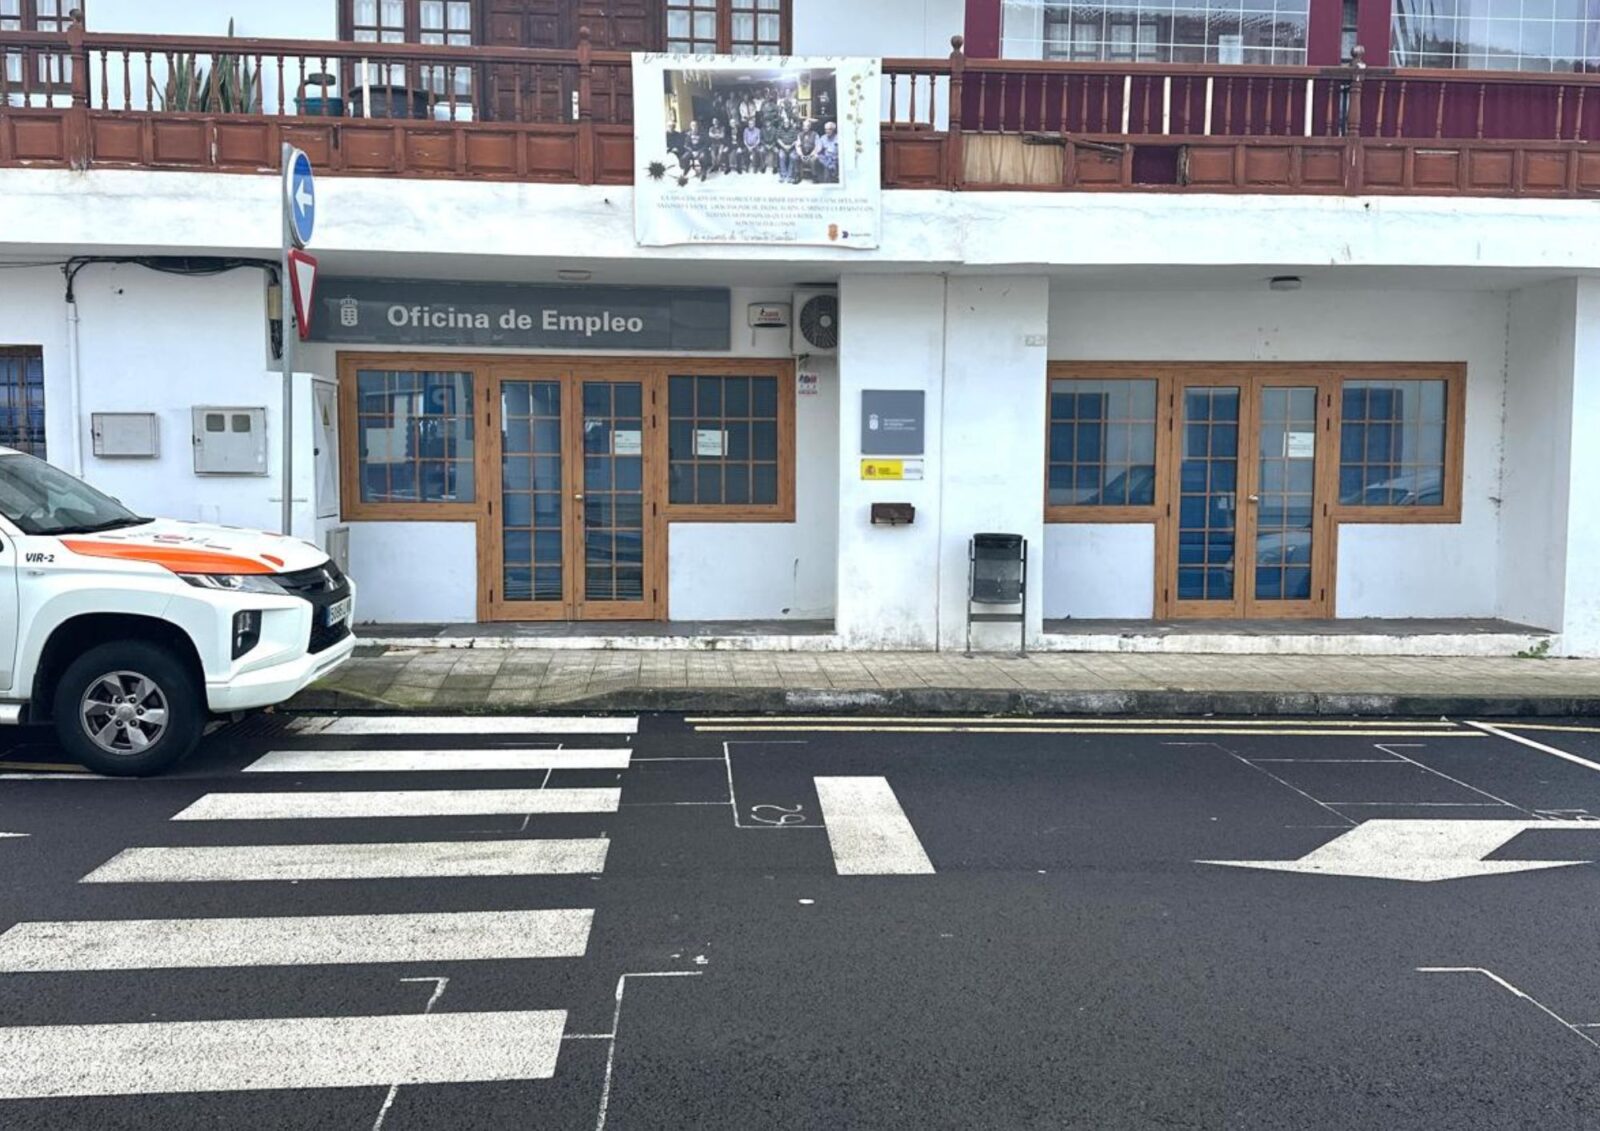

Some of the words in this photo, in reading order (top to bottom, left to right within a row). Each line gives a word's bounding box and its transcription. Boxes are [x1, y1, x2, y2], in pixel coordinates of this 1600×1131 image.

[387, 305, 489, 328] Oficina
[499, 309, 532, 329] de
[542, 310, 643, 336] Empleo
[26, 552, 55, 562] VIR-2
